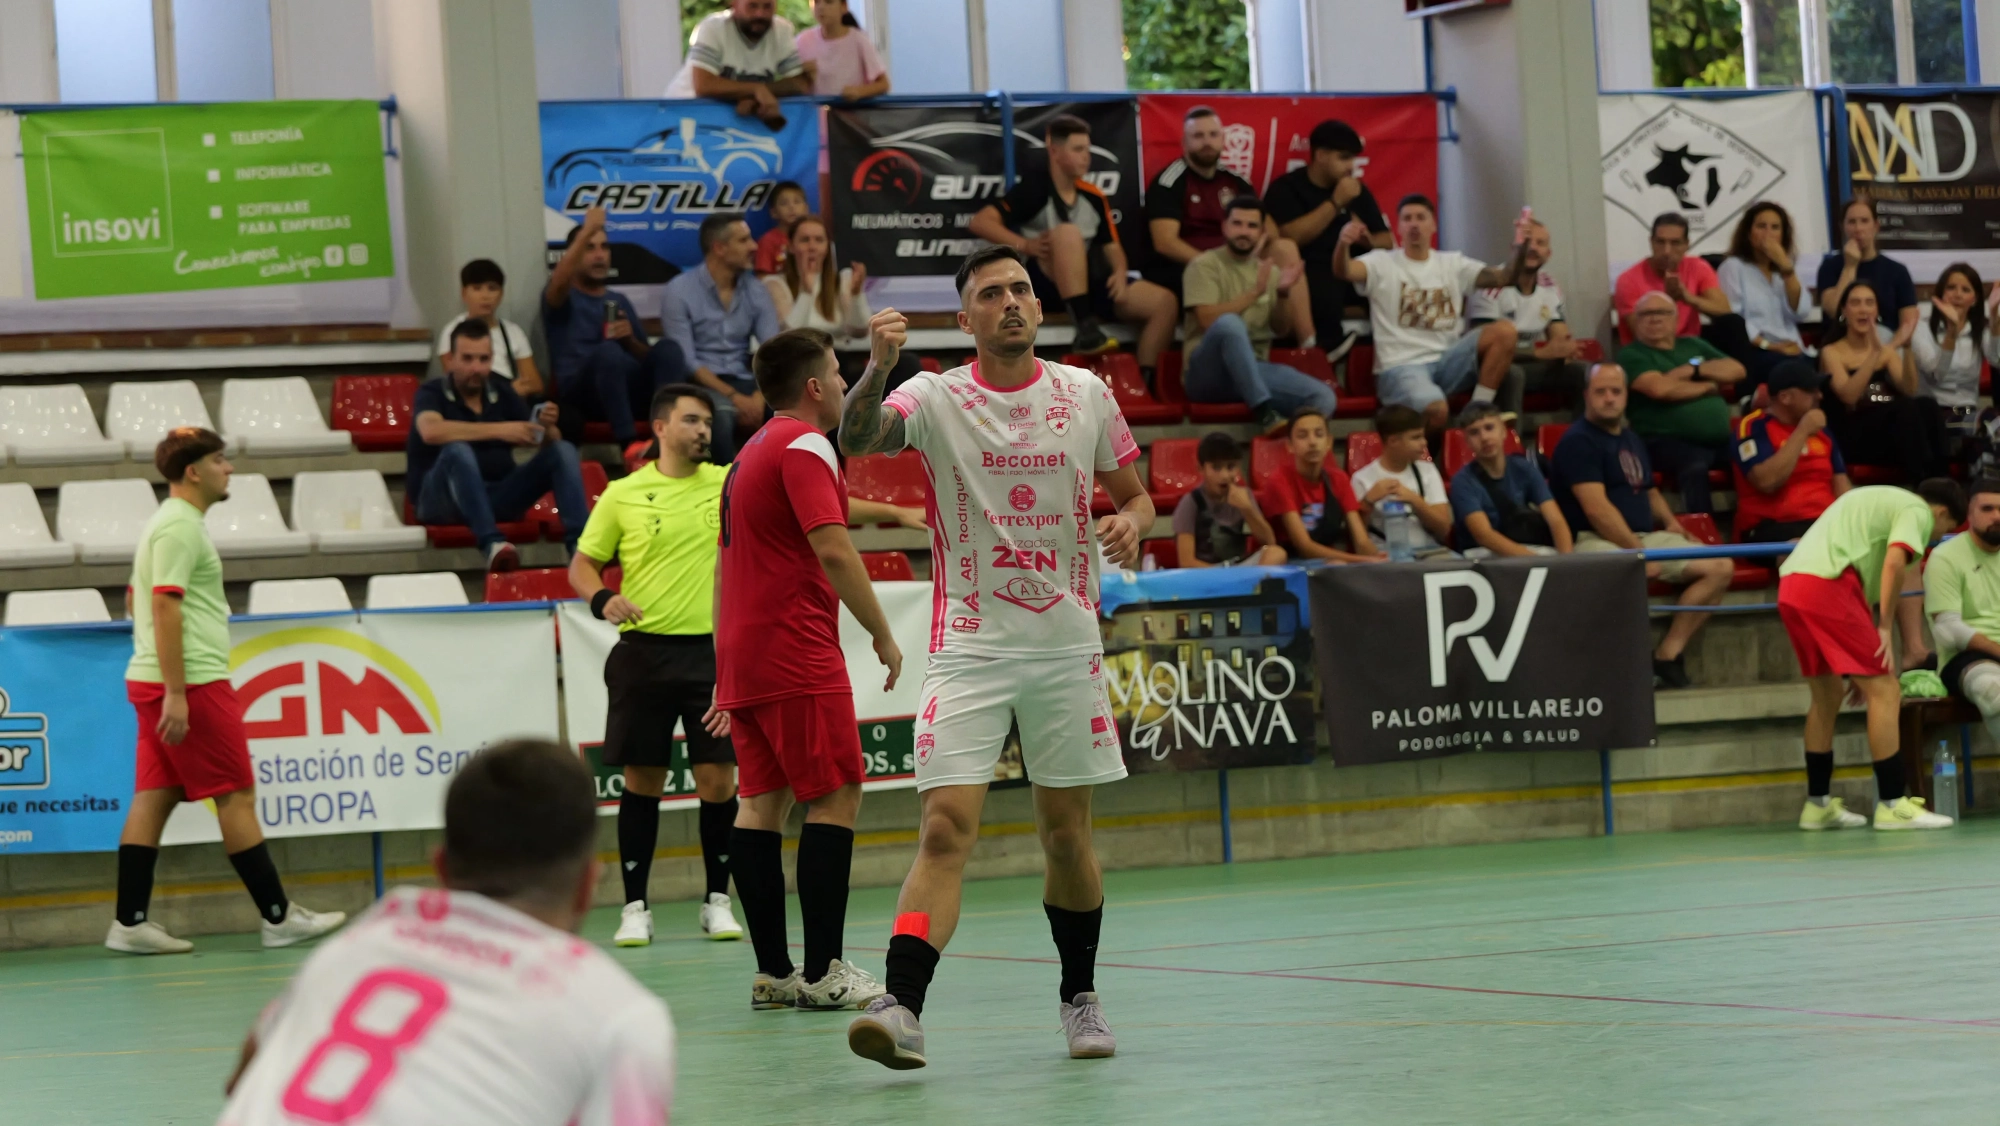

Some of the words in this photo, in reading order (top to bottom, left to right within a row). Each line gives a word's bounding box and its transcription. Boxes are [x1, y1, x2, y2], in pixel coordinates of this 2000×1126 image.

[231, 127, 304, 145] TELEFONÍA
[235, 162, 333, 181] INFORMÁTICA
[238, 200, 310, 217] SOFTWARE
[63, 208, 161, 244] insovi
[238, 221, 277, 235] PARA
[281, 215, 351, 233] EMPRESAS
[981, 451, 1066, 468] Beconet
[953, 465, 970, 543] Rodriguez
[983, 509, 1064, 530] ferrexpor
[961, 556, 973, 581] AR
[991, 546, 1056, 573] ZEN
[1102, 654, 1296, 707] MOLINO
[236, 660, 432, 739] GM
[922, 696, 938, 725] 4
[1372, 703, 1462, 730] PALOMA
[1469, 697, 1604, 719] VILLAREJO
[1171, 700, 1298, 750] NAVA
[1502, 730, 1513, 743] &
[1523, 729, 1580, 744] SALUD
[251, 748, 364, 784] stación
[374, 746, 405, 777] de
[26, 795, 120, 813] necesitas
[262, 790, 377, 827] UROPA
[281, 966, 450, 1124] 8
